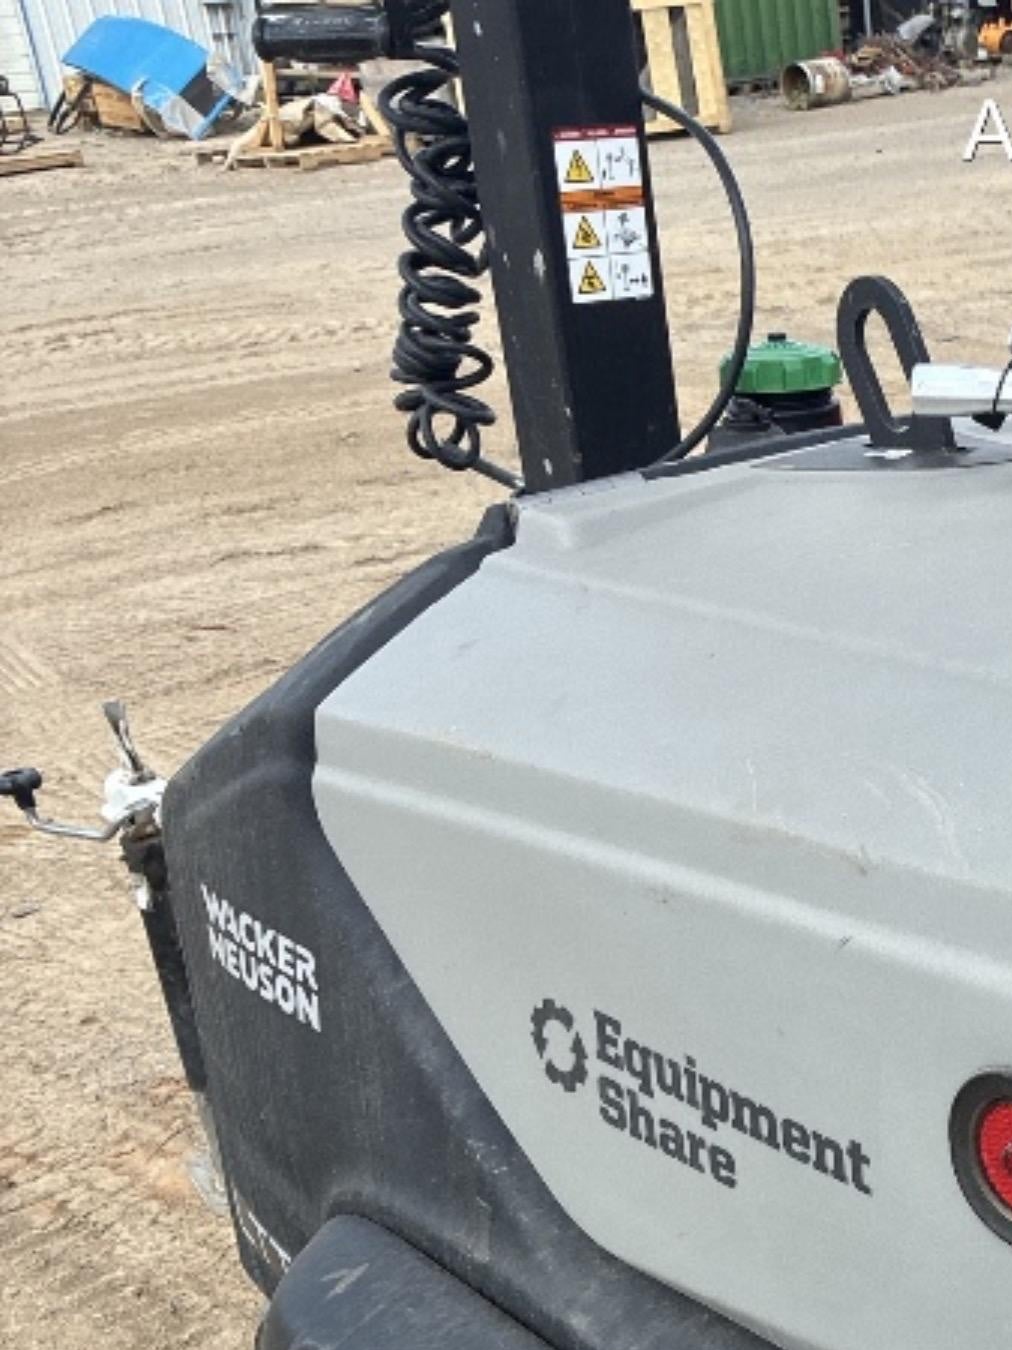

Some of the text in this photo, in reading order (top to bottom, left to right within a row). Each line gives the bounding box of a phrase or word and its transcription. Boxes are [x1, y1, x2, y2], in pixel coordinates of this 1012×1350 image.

[200, 883, 319, 991] WACKER
[208, 923, 322, 1033] NEUSON
[593, 1009, 873, 1197] Equipment
[597, 1075, 739, 1190] Share
